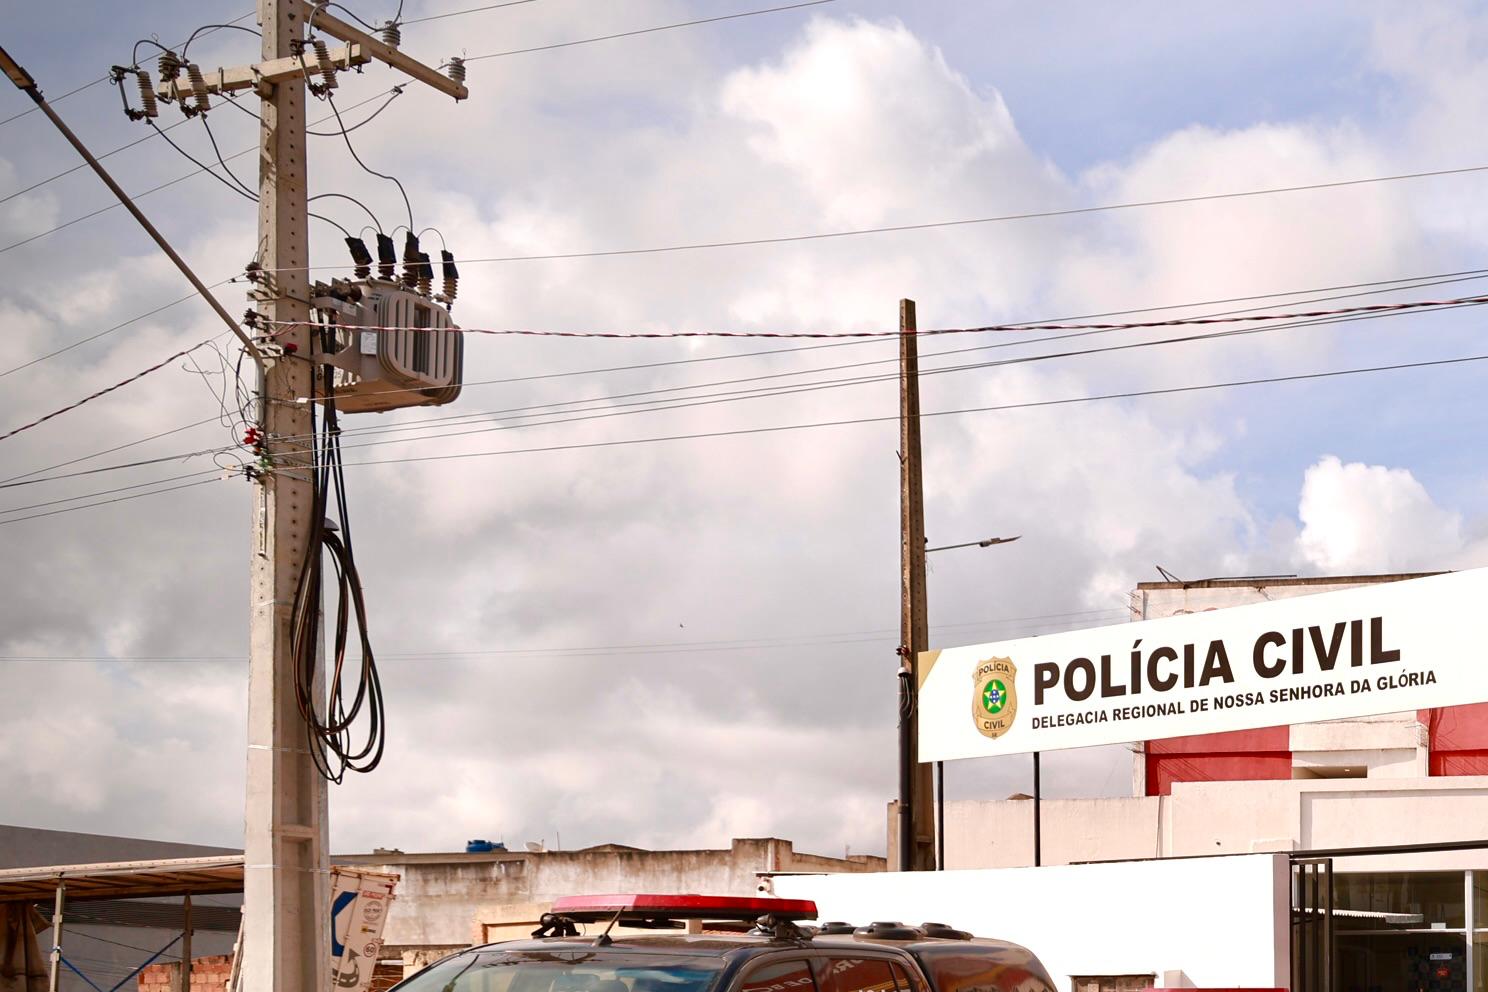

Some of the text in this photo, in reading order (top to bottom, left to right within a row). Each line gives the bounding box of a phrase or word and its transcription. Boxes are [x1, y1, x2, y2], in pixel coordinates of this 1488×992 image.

[978, 660, 1010, 676] POLÍCIA
[1034, 616, 1400, 705] POLÍCIA CIVIL
[1032, 669, 1437, 730] DELEGACIA REGIONAL DE NOSSA SENHORA DA GLÓRIA
[984, 720, 1005, 729] CIVIL
